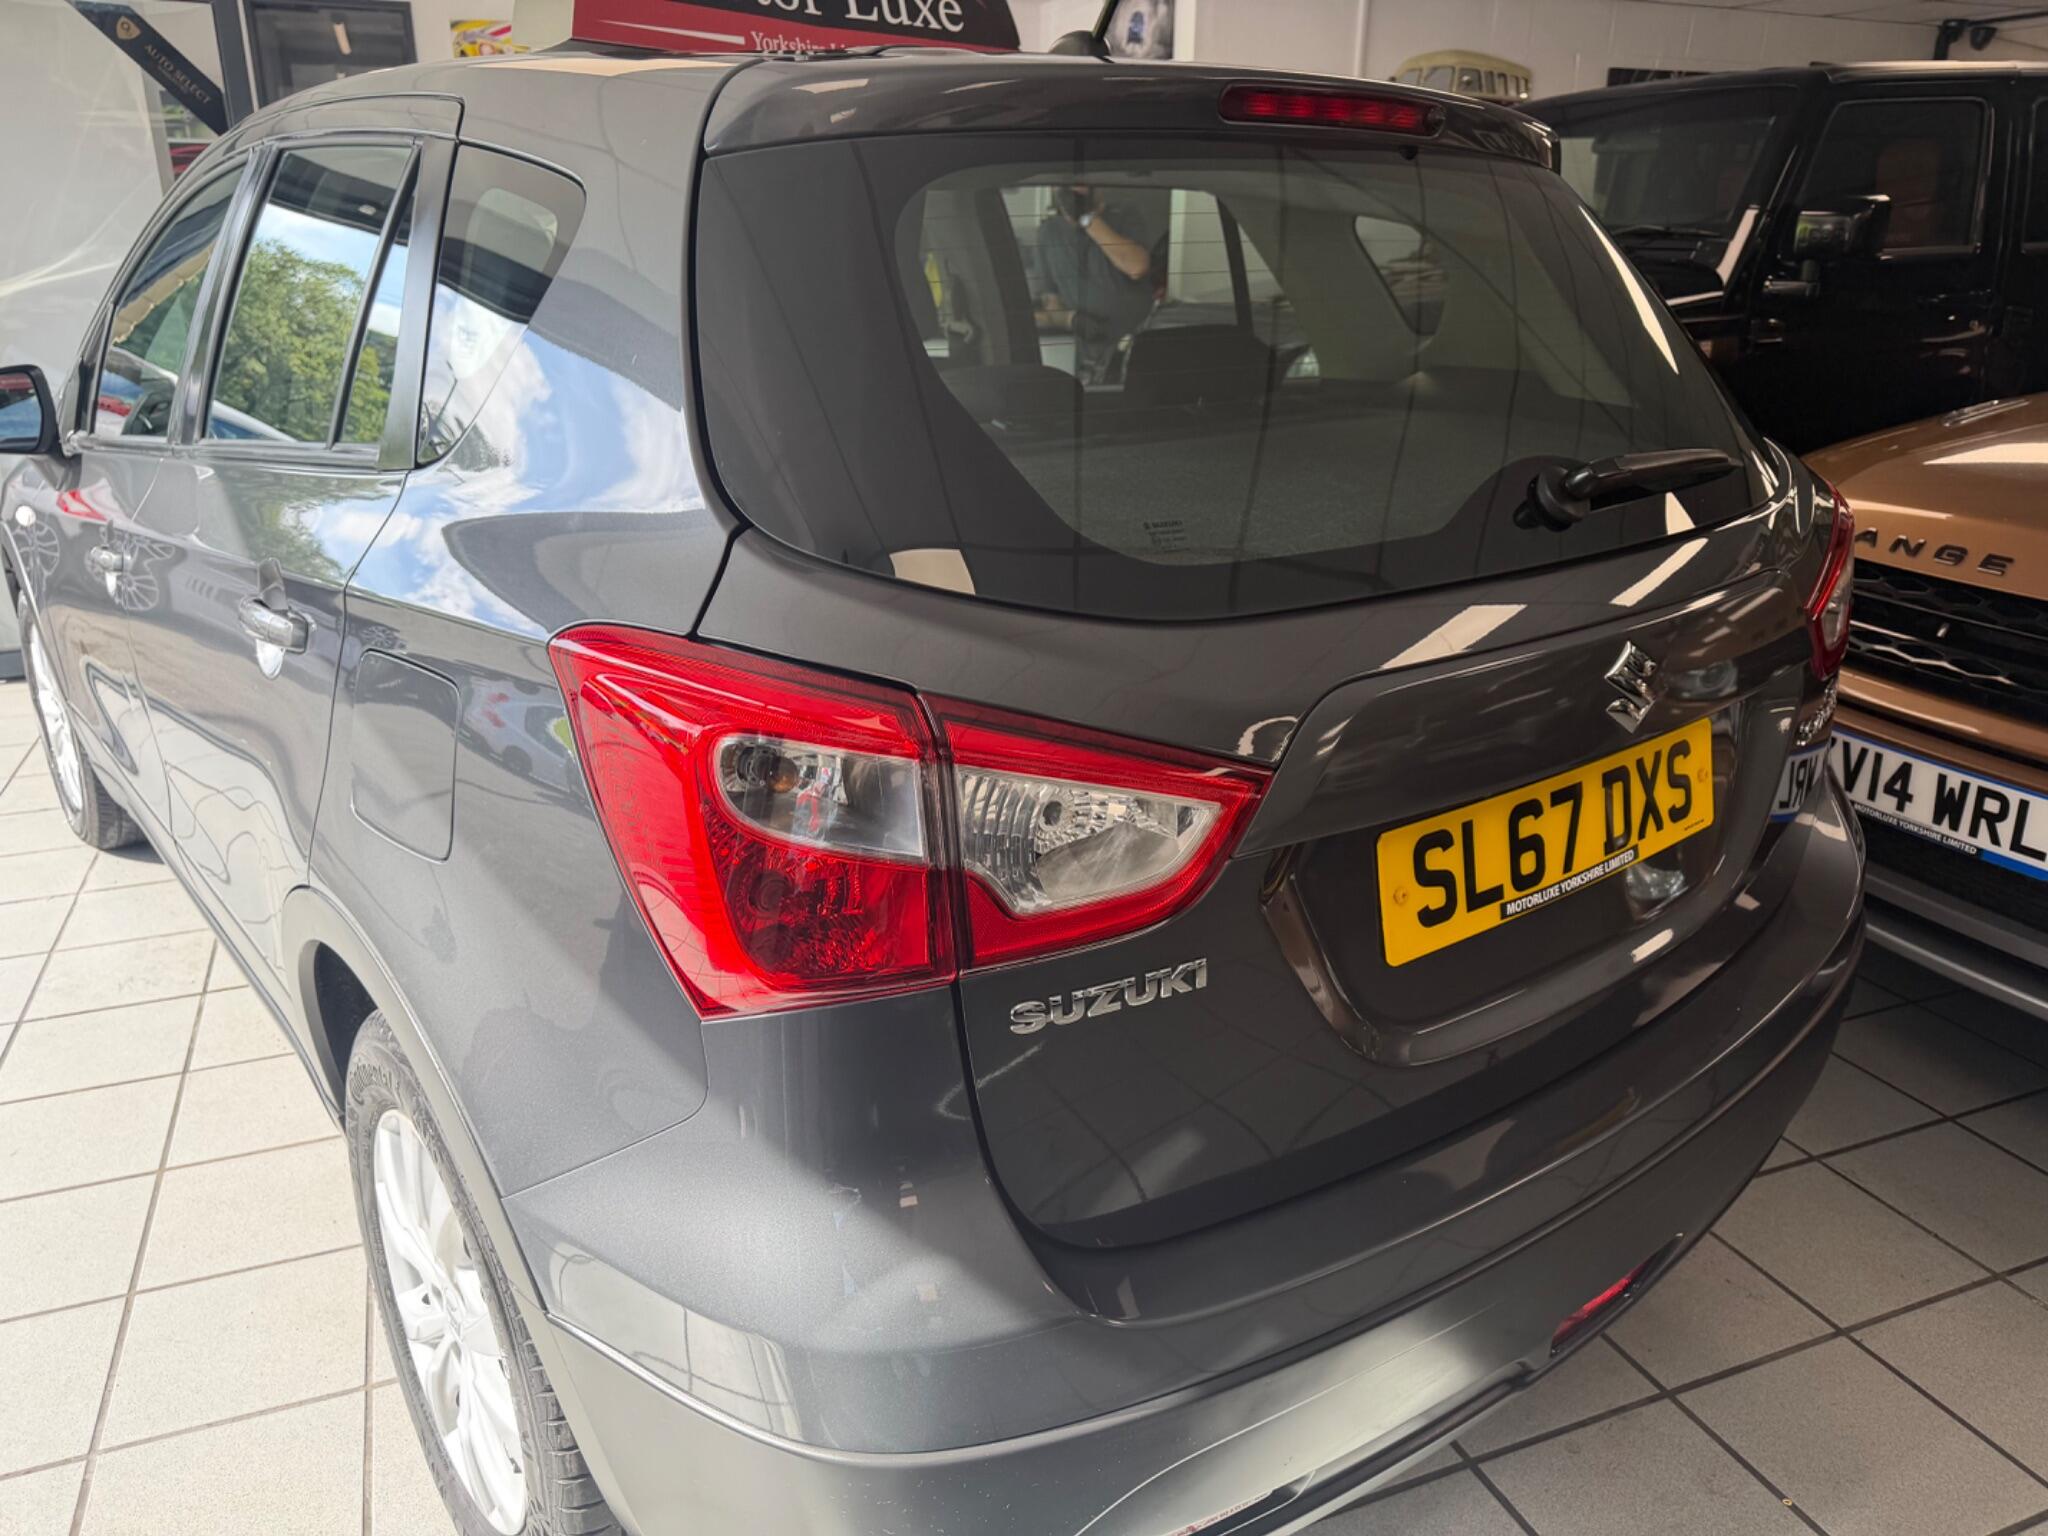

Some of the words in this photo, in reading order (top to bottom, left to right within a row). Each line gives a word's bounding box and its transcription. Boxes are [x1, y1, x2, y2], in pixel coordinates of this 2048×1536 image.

[145, 44, 174, 72] AUTO
[1413, 781, 1583, 929] SL67
[1602, 738, 1692, 856] DXS
[1831, 736, 1914, 813] V14
[1932, 773, 2047, 862] WRL
[1854, 802, 1898, 827] MOTORLUXE
[1899, 821, 1942, 841] YORKSHIRE
[1942, 835, 1977, 855] LIMITED
[1506, 884, 1561, 915] MOTORLUXE
[1560, 864, 1605, 893] YORKSHIRE
[1604, 848, 1635, 874] LIMITED
[1010, 957, 1207, 1035] SUZUKI
